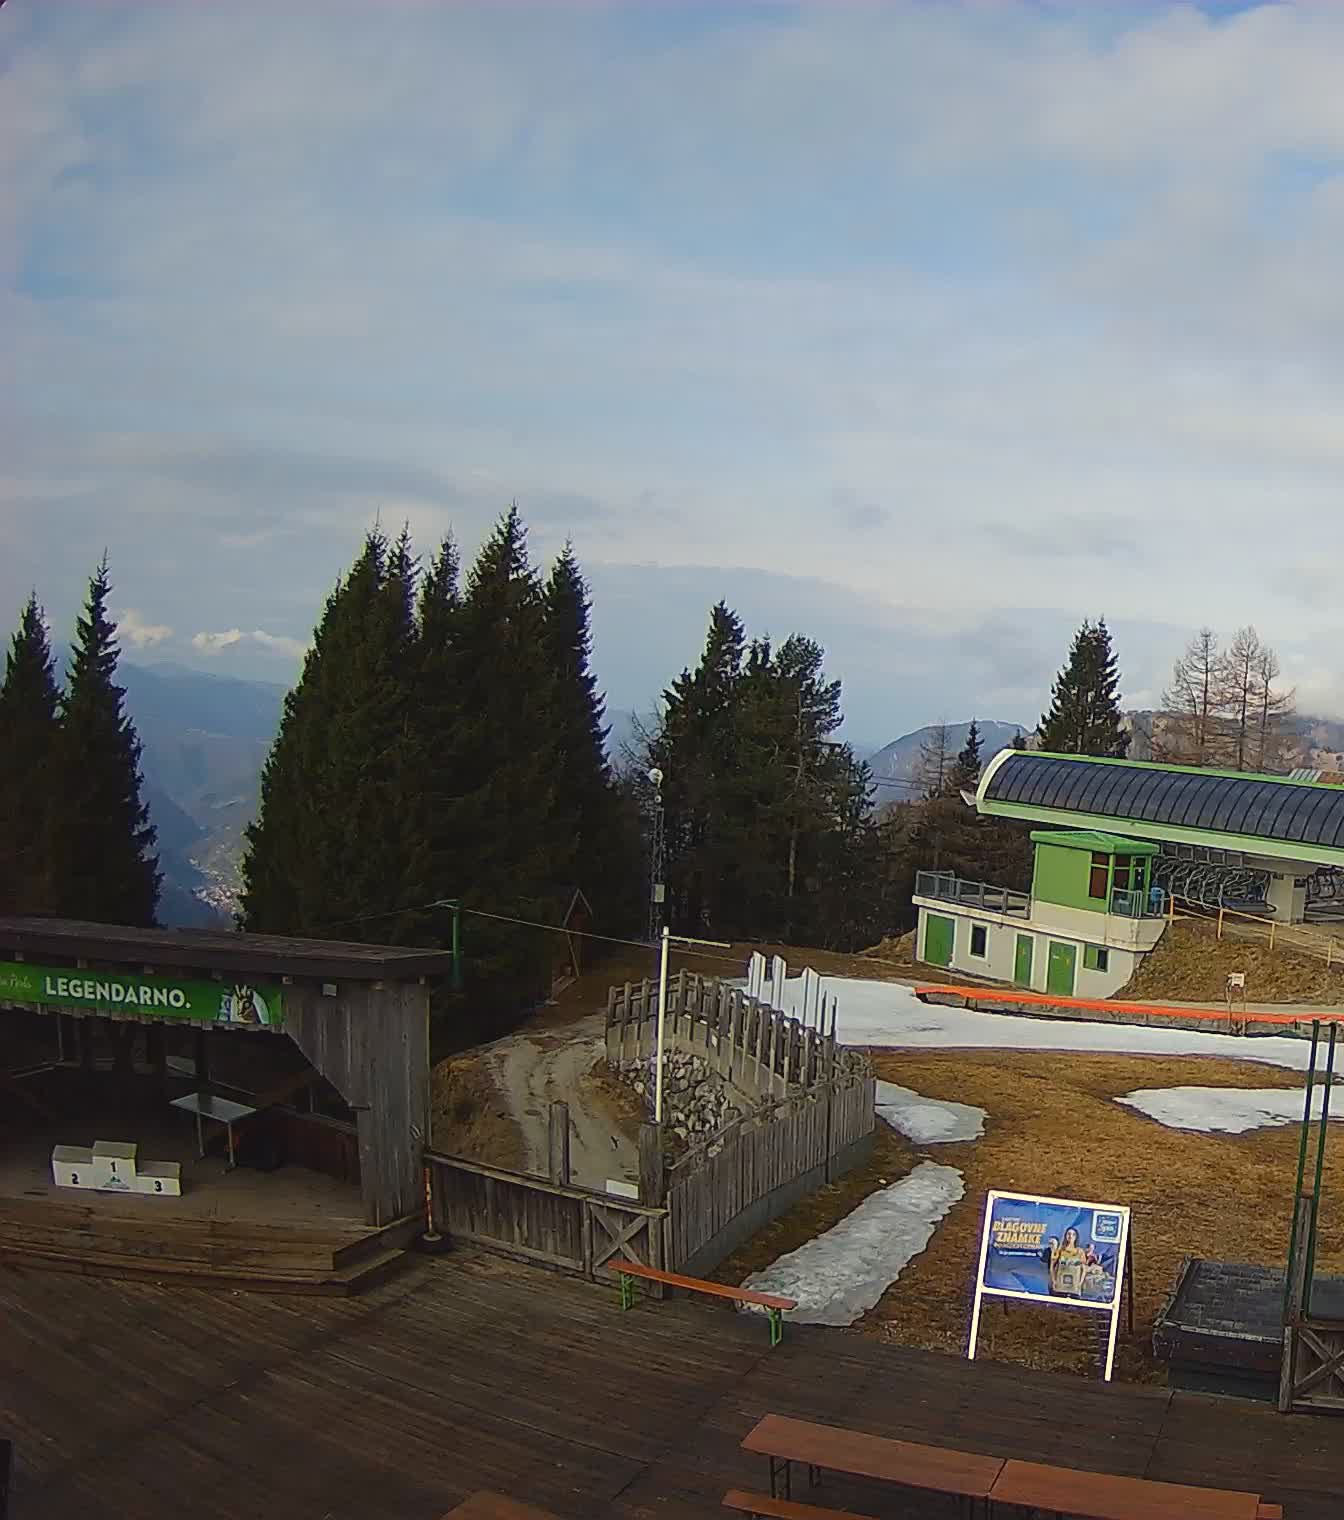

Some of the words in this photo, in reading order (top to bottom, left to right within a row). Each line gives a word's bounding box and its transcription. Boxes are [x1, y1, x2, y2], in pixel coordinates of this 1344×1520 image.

[45, 976, 192, 1009] LEGENDARNO.
[71, 1173, 80, 1185] 2
[154, 1180, 163, 1192] 3
